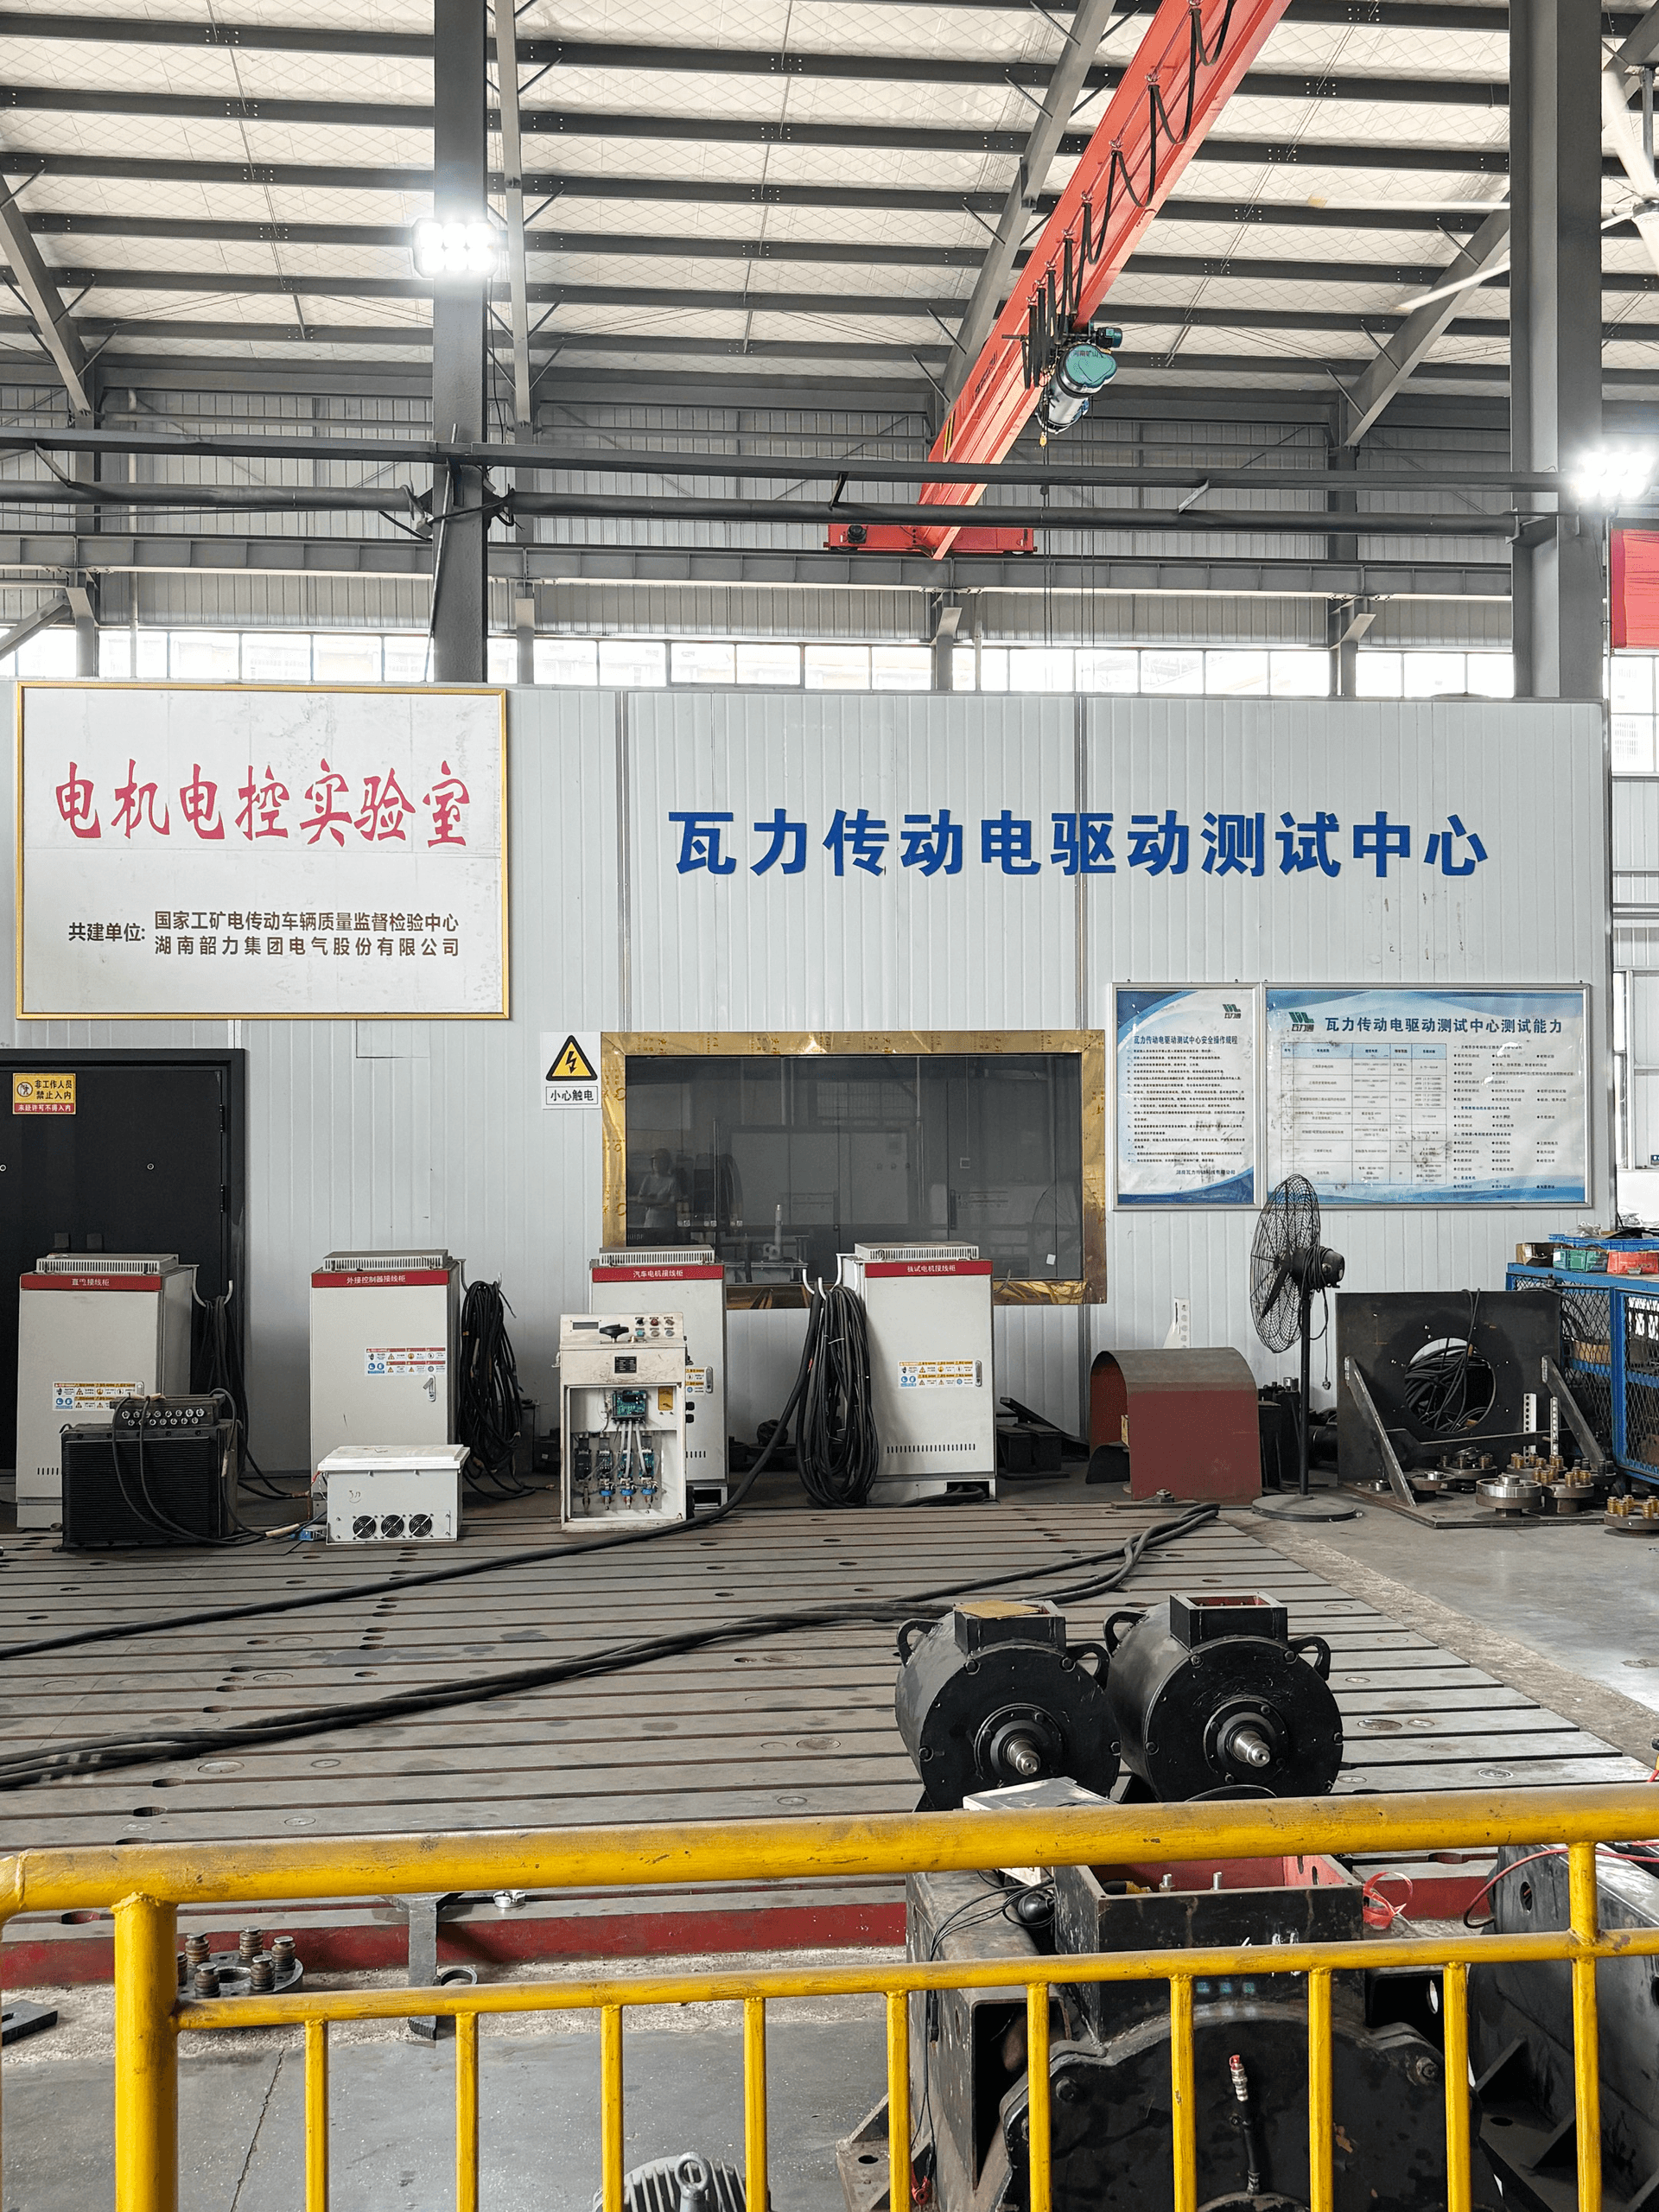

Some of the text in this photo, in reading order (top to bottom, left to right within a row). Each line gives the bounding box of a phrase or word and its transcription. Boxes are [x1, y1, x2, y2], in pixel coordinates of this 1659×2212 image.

[55, 759, 470, 847] 电机电控实验室
[668, 808, 1488, 878] 瓦力传动电驱动测试中心
[155, 911, 460, 932] 国家工矿电传动车辆质量监督检验中心
[68, 922, 145, 943] 共建单位:
[155, 936, 459, 957] 湖南韶力集团电气股份有限公司
[1325, 1017, 1562, 1033] 瓦力传动电驱动测试中心测试能力
[1134, 1035, 1238, 1045] 瓦力传动电驱动测试中心安全操作规程
[35, 1080, 73, 1089] 非工作人员
[36, 1090, 72, 1100] 禁止入内
[550, 1090, 594, 1102] 小心触电
[632, 1269, 683, 1279] 汽车电机接线柜
